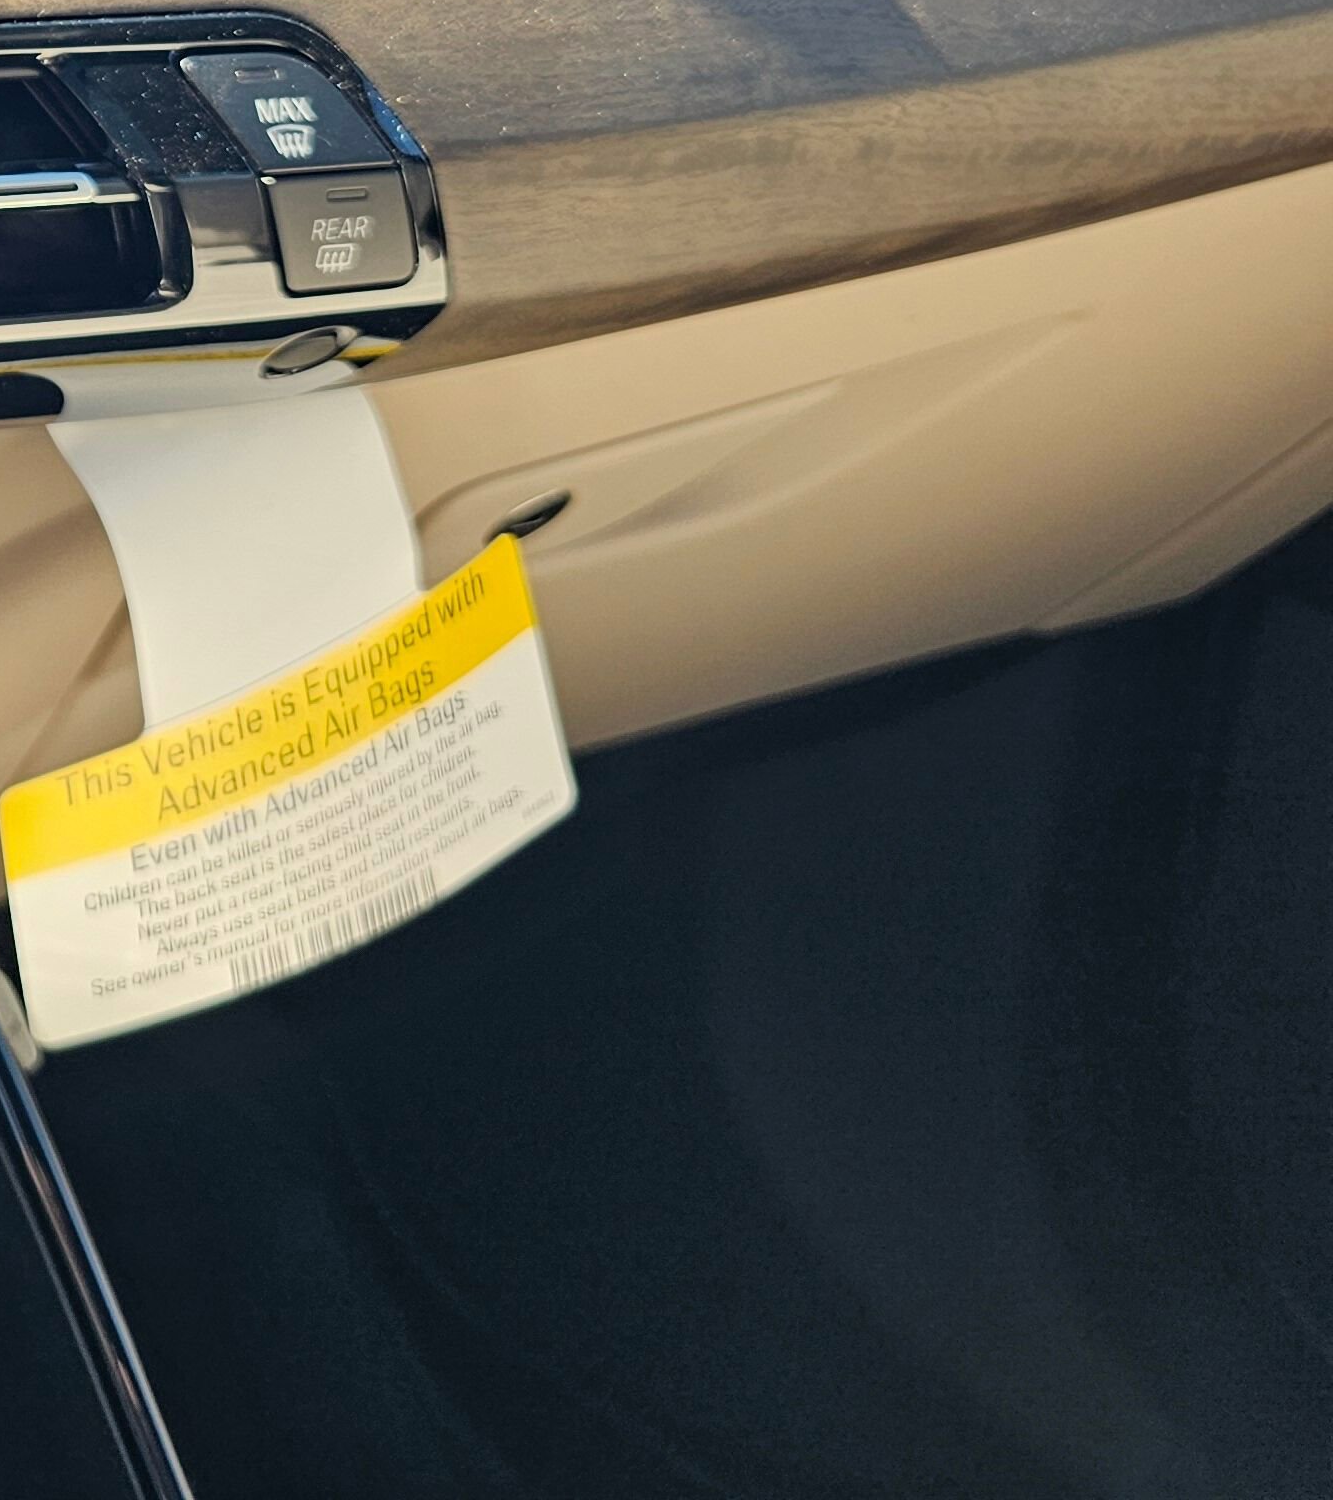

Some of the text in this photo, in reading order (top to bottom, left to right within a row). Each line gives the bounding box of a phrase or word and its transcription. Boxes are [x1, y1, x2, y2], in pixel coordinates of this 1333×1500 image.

[254, 96, 318, 125] MAX
[311, 215, 371, 242] REAR
[56, 566, 485, 807] This Vehicle is Equipped with
[157, 660, 435, 823] Advanced Air Bags
[84, 877, 161, 911] Children
[165, 865, 197, 886] can
[201, 854, 225, 873] be
[227, 829, 272, 864] killed
[276, 826, 292, 843] or
[296, 787, 364, 833] seriously
[366, 758, 415, 798] injured
[416, 746, 433, 767] by
[434, 731, 455, 754] the
[459, 719, 473, 738] air
[130, 689, 466, 872] Even with Advanced Air Bags
[135, 898, 171, 918] The
[174, 878, 217, 907] back
[221, 866, 257, 890] seat
[260, 856, 275, 874] is
[279, 843, 305, 866] the
[308, 817, 355, 847] safest
[358, 796, 397, 830] place
[399, 781, 419, 802] for
[90, 975, 128, 996] See
[131, 950, 203, 986] owner's
[206, 927, 271, 963] manual
[273, 914, 297, 938] for
[300, 894, 343, 924] more
[344, 846, 430, 902] information
[434, 823, 469, 854] about
[136, 913, 190, 941] Never
[195, 901, 224, 926] put
[242, 855, 332, 904] rear-facing
[335, 832, 373, 862] child
[375, 816, 406, 840] seat
[407, 805, 421, 822] in
[423, 790, 444, 813] the
[156, 927, 219, 956] Always
[222, 912, 254, 933] use
[257, 891, 293, 920] seat
[296, 874, 336, 902] belts
[339, 861, 369, 884] and
[371, 837, 406, 867] child
